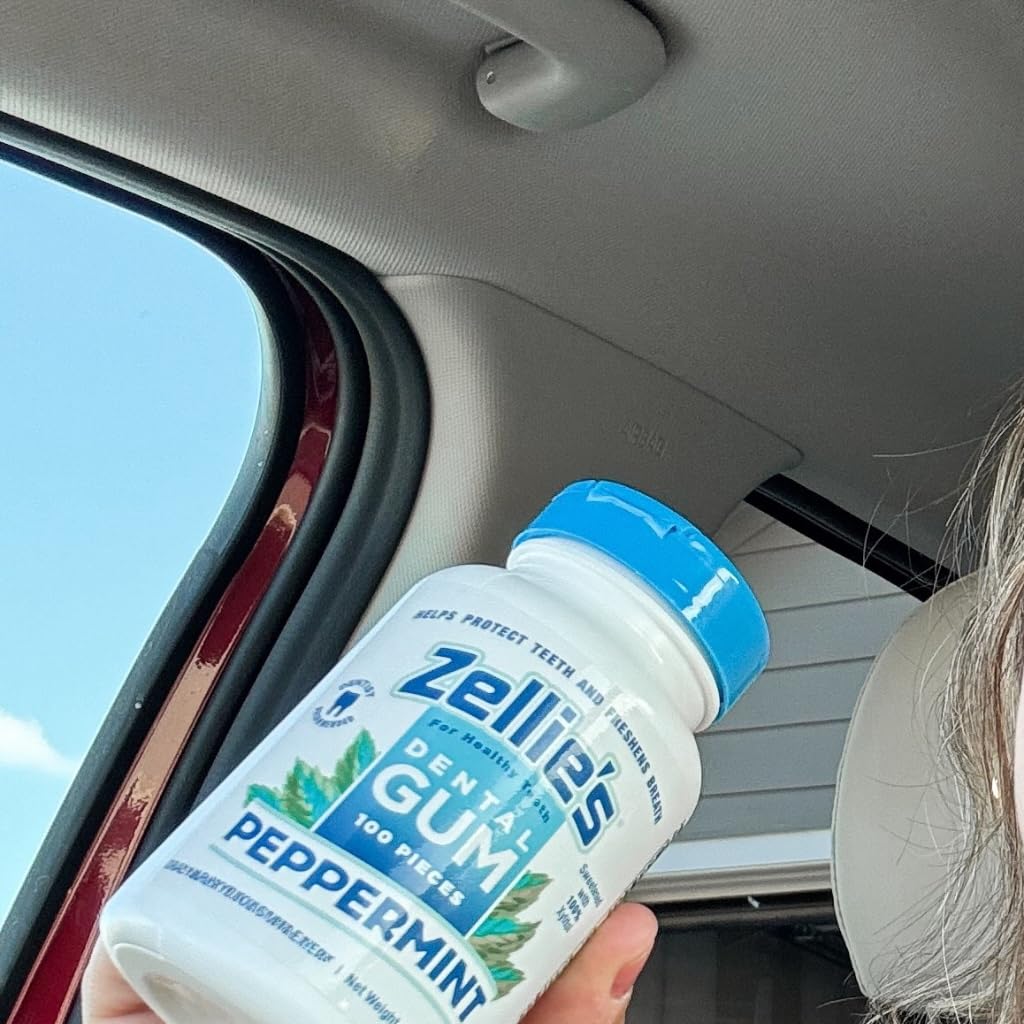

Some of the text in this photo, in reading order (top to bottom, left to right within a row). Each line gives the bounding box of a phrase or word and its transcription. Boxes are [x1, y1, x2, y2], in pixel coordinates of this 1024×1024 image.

[397, 646, 614, 847] Zellie's
[412, 610, 458, 620] HELPS
[461, 614, 528, 645] PROTECT
[530, 642, 576, 679] TEETH
[576, 679, 605, 706] AND
[646, 776, 663, 825] BREATH
[428, 719, 550, 824] For Healthy Teth
[372, 763, 518, 894] GUM
[404, 737, 532, 853] DENTAL
[223, 811, 486, 1023] PEPPERMINT
[354, 812, 465, 906] 100 PIECES
[566, 895, 582, 922] 100%
[344, 973, 368, 996] Net
